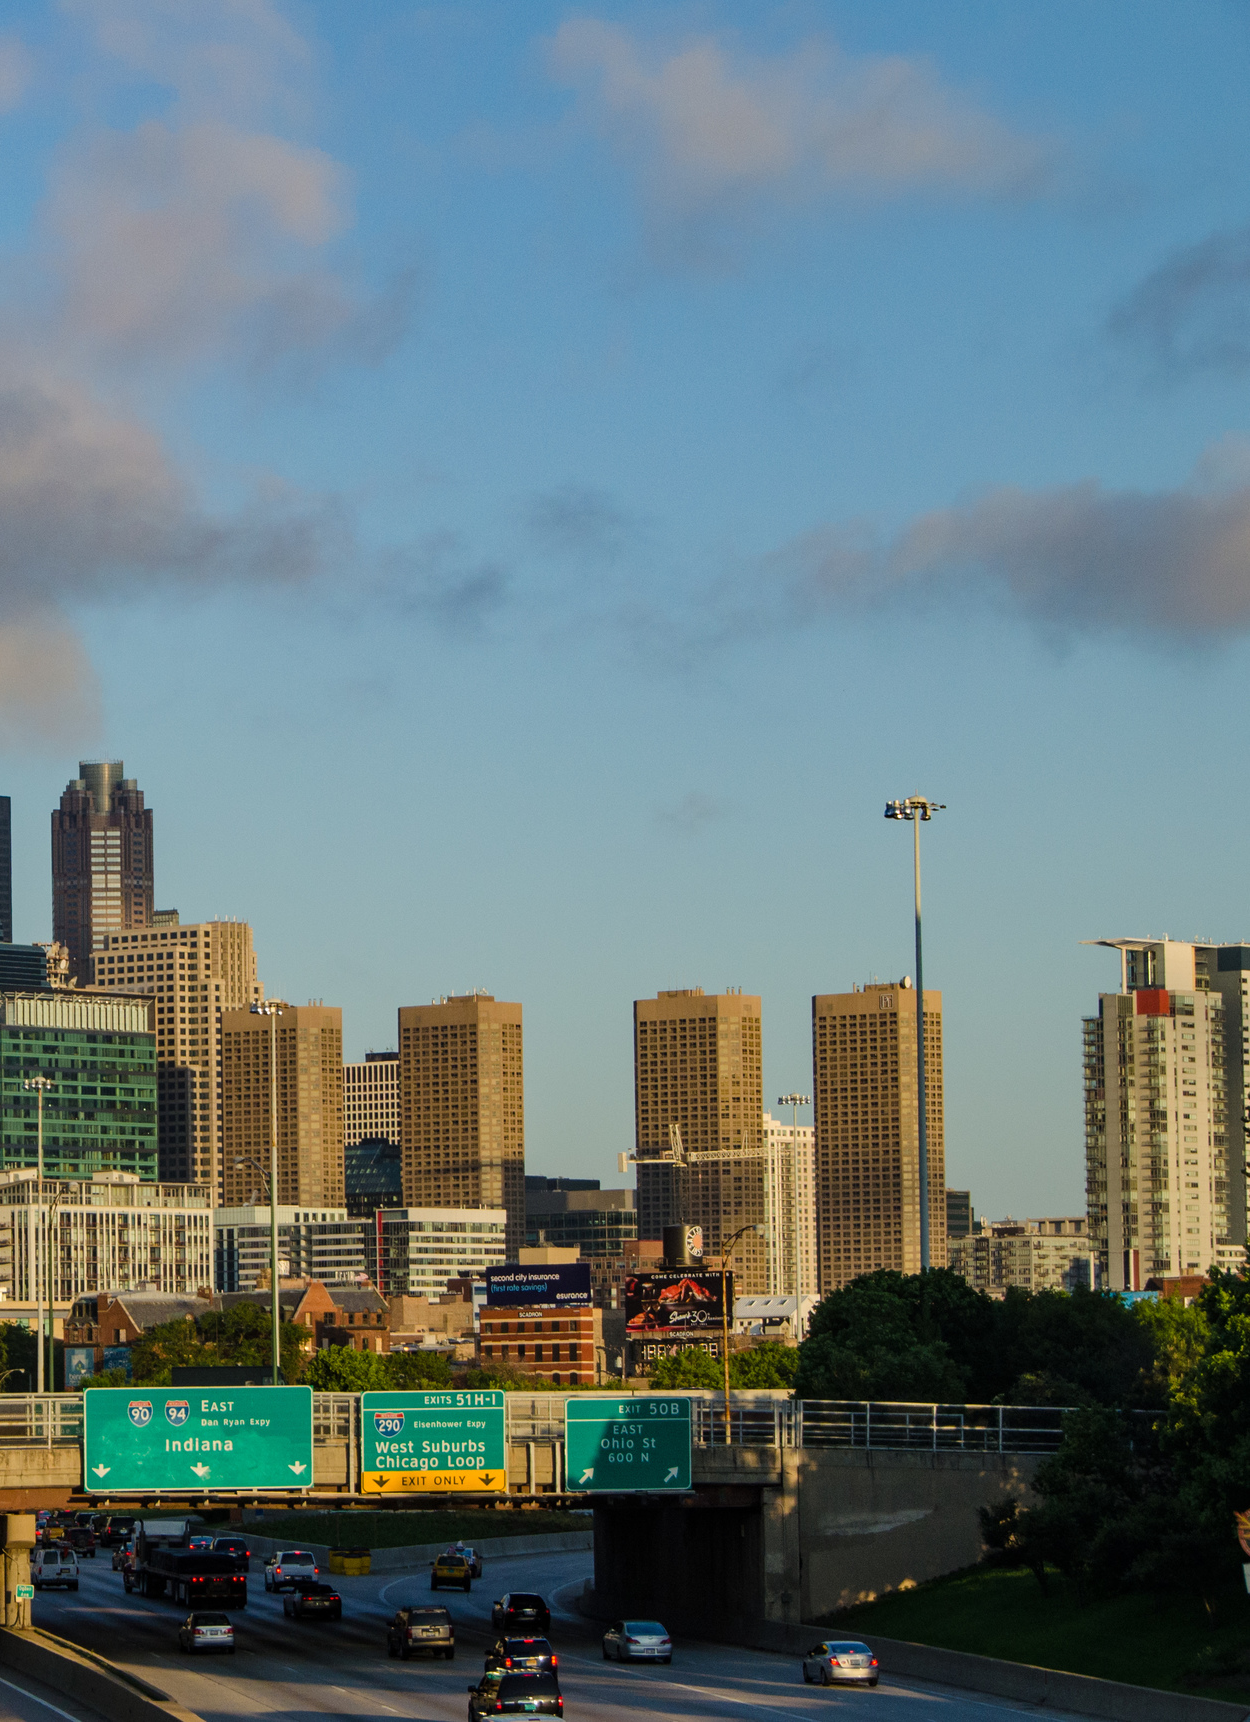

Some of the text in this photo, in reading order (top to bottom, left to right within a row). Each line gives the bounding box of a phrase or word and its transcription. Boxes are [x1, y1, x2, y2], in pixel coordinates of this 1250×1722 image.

[490, 1272, 560, 1282] second city insurance
[491, 1282, 548, 1293] (first rate savings)
[556, 1292, 587, 1300] esurance
[424, 1396, 452, 1404] EXITS
[201, 1400, 235, 1412] EAST
[618, 1403, 680, 1415] EXIT 50B
[131, 1408, 150, 1421] 90
[168, 1408, 186, 1420] 94
[201, 1418, 270, 1427] Dan Ryan Expy
[378, 1419, 401, 1432] 290
[413, 1420, 486, 1429] Eisenhower Expy
[613, 1424, 643, 1435] EAST
[165, 1437, 234, 1452] Indiana
[375, 1439, 486, 1453] West Suburbs
[600, 1437, 656, 1449] Ohio St
[608, 1452, 649, 1462] 600 N
[375, 1455, 485, 1471] Chicago Loop
[401, 1476, 466, 1486] EXIT ONLY
